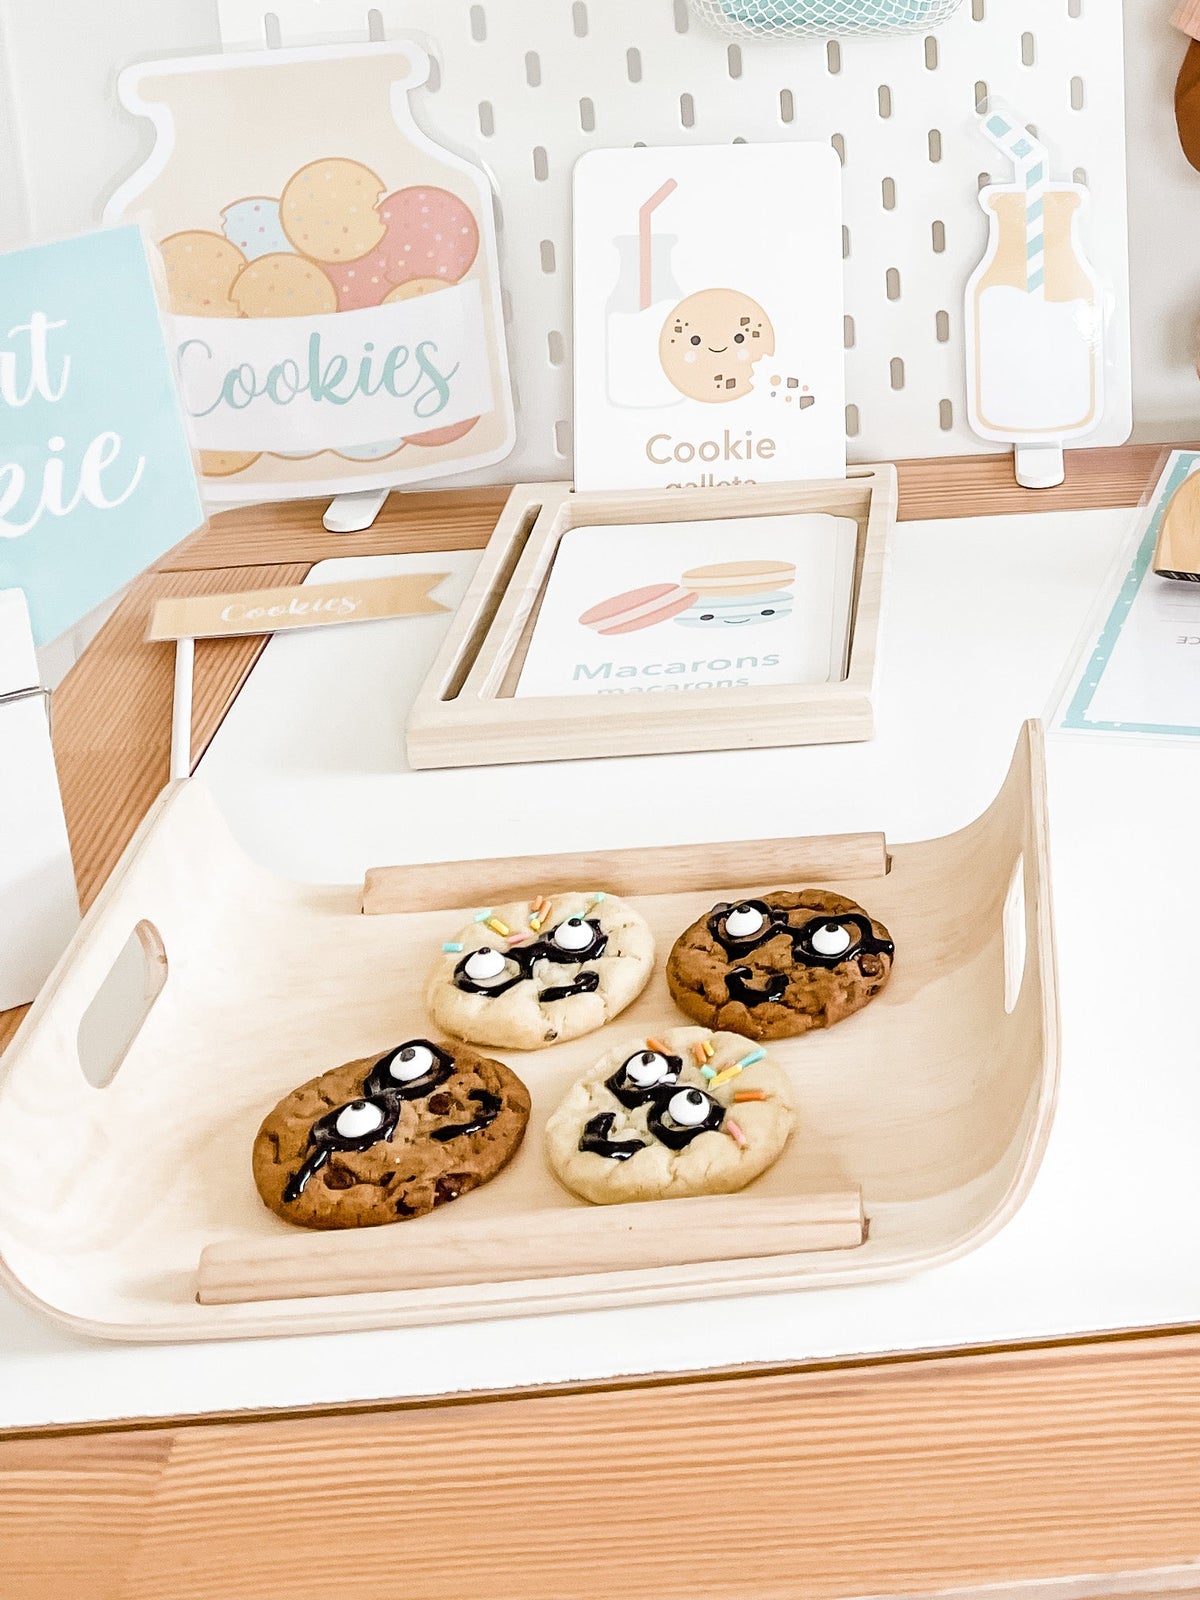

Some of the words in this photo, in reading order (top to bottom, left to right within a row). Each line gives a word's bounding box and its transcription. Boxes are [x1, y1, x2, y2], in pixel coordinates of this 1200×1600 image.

[176, 331, 460, 419] Cookies
[645, 429, 777, 465] Cookie
[220, 594, 363, 623] Cookies
[572, 654, 781, 681] Macarons
